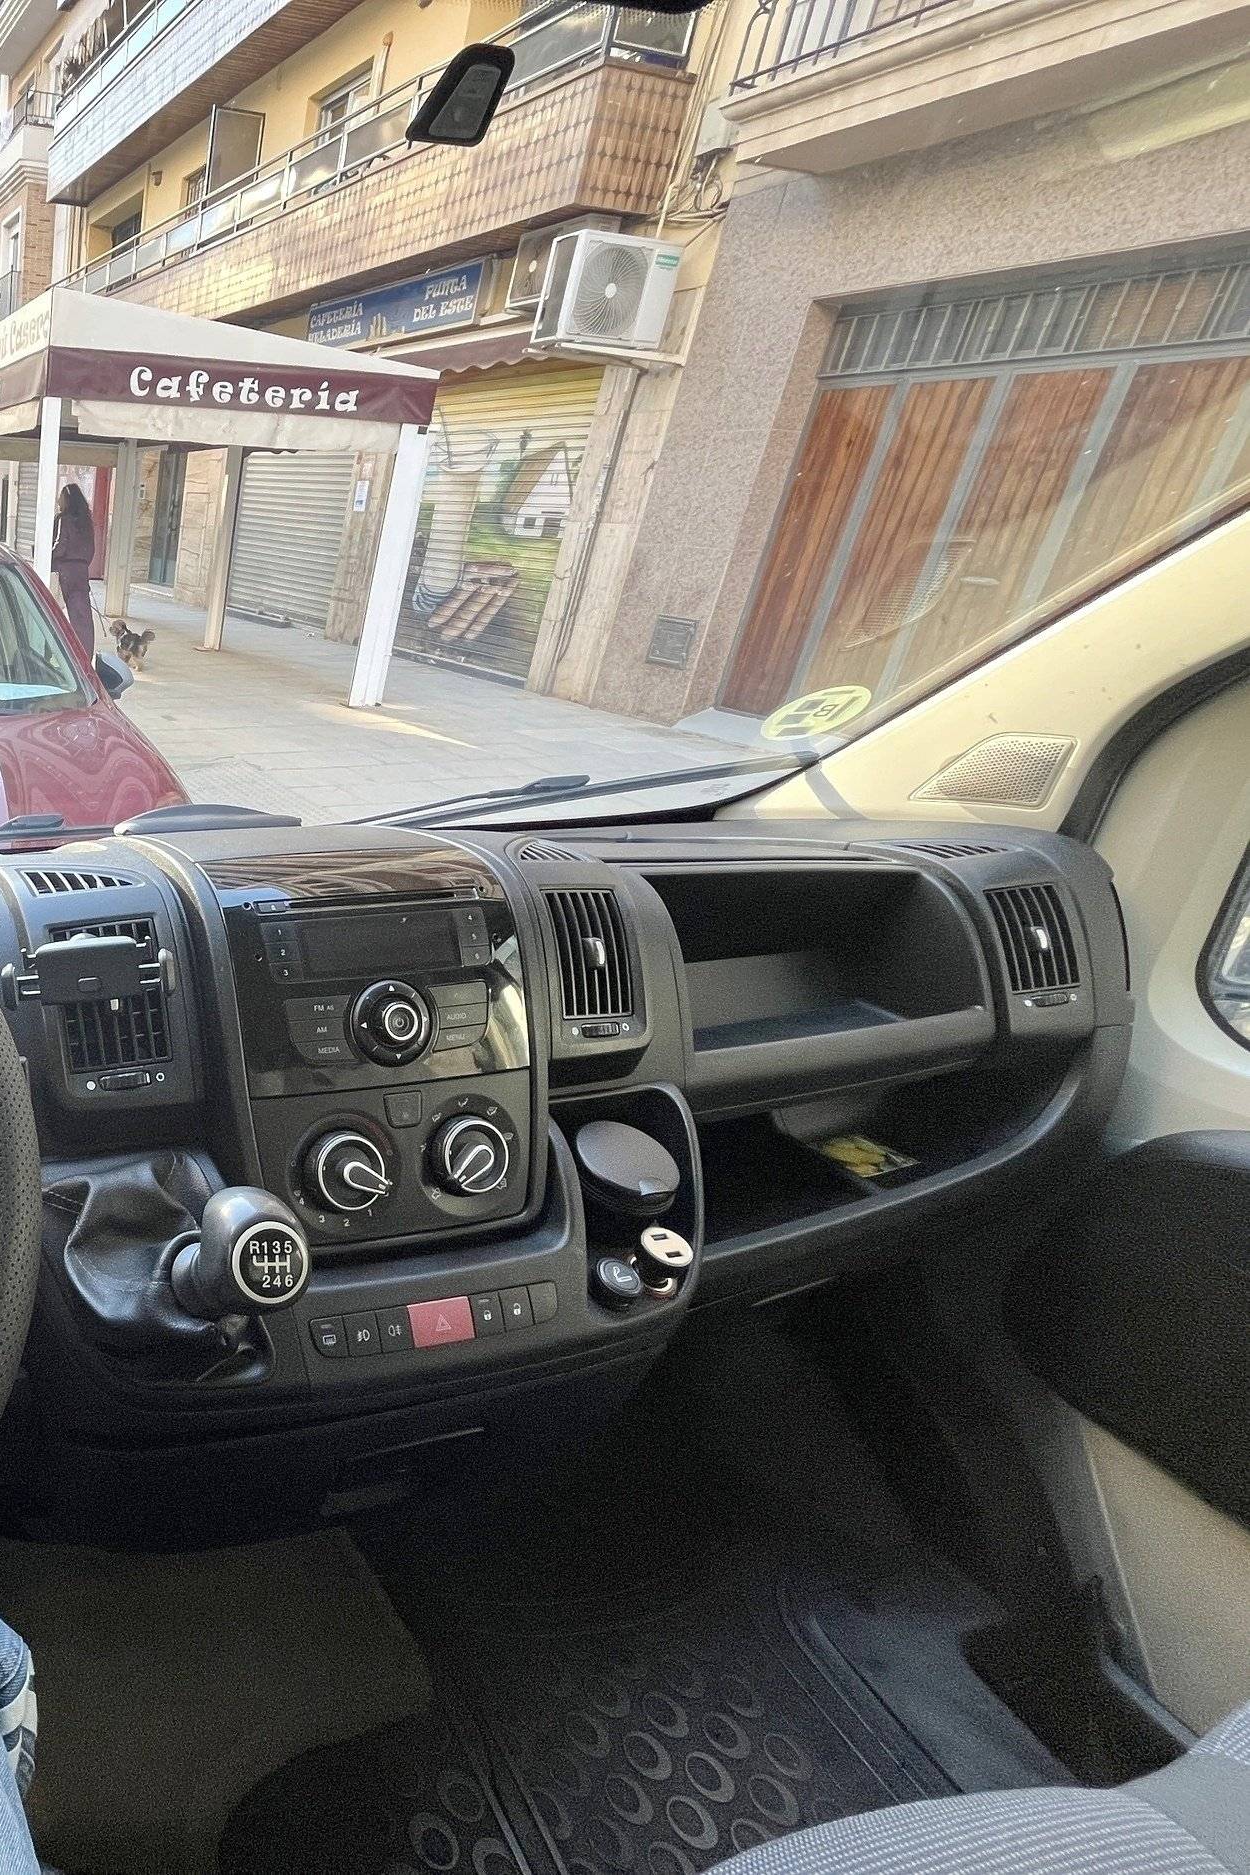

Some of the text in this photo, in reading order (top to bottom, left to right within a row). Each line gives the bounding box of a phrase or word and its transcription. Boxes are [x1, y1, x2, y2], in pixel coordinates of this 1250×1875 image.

[412, 295, 474, 322] DEL ESTE
[129, 366, 360, 412] Cafetería
[318, 1214, 326, 1223] 3
[343, 1218, 351, 1227] 2
